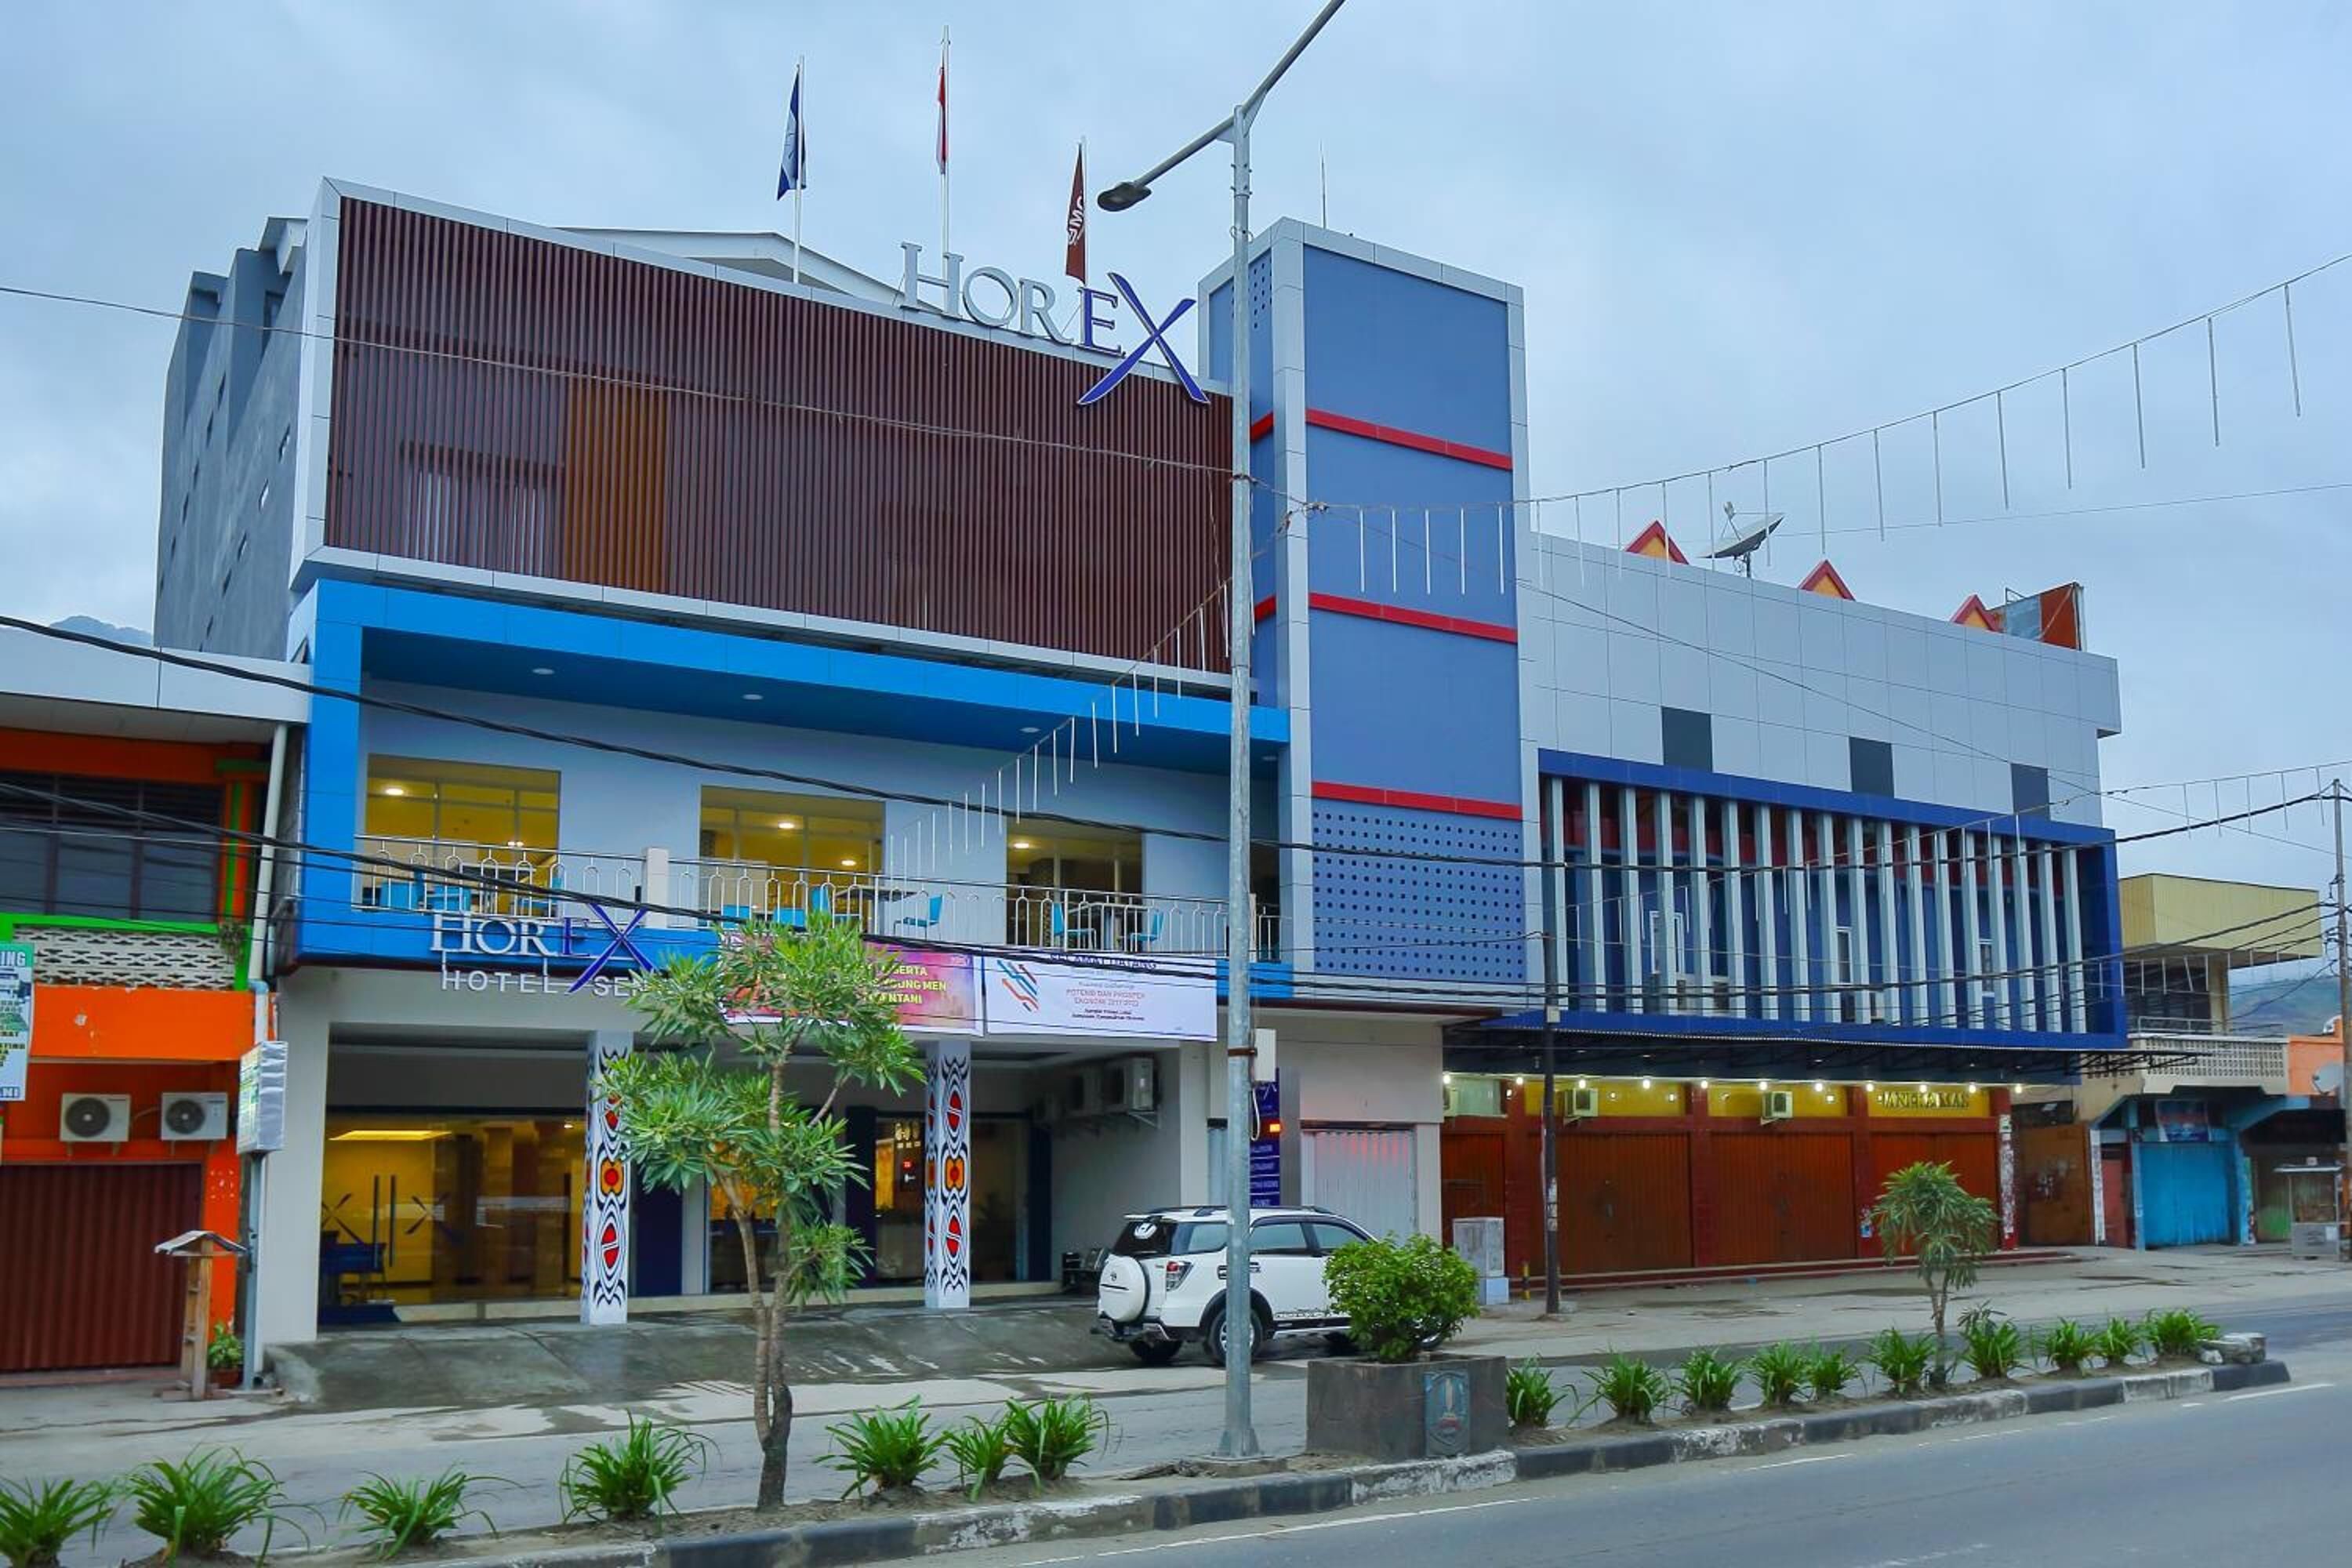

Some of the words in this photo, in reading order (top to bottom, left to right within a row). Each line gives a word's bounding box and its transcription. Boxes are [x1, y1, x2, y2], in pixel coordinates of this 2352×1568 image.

[899, 241, 1211, 407] HOREX
[430, 902, 655, 996] HOREX
[441, 970, 558, 994] HOTEL
[923, 981, 946, 991] MEN
